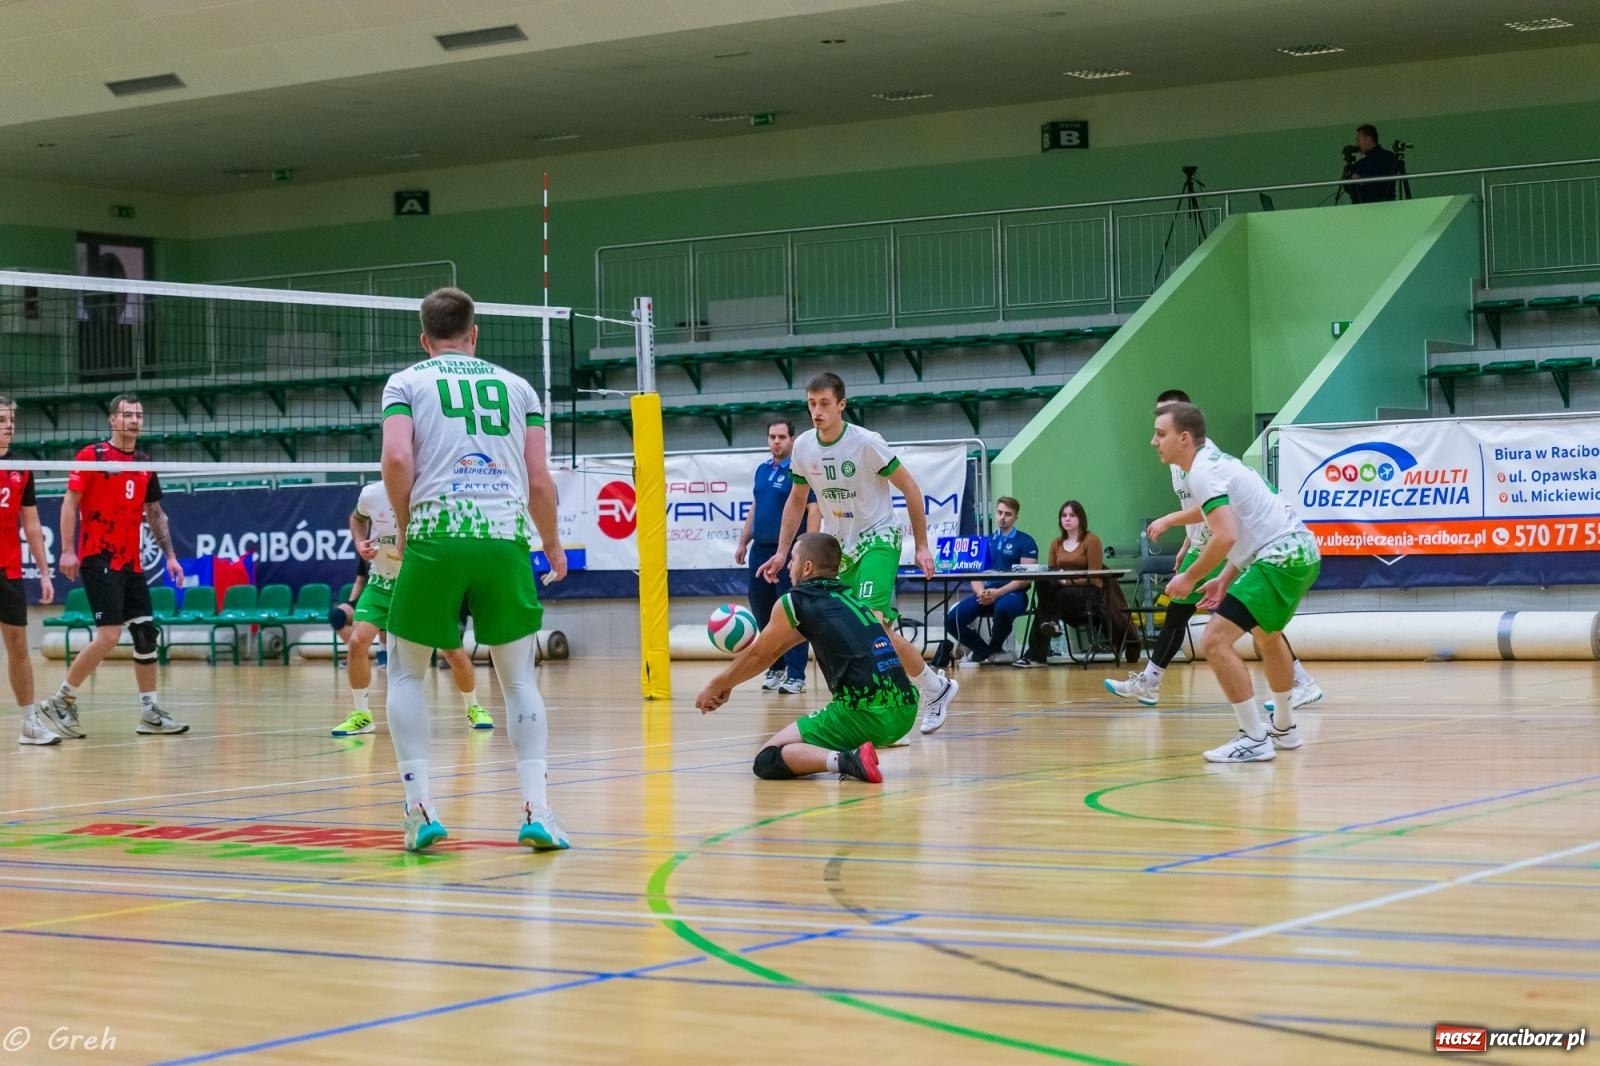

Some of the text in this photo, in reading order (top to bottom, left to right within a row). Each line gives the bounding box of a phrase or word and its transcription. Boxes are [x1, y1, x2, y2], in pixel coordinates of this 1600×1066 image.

[1060, 130, 1080, 146] B
[402, 199, 423, 213] A
[436, 379, 511, 437] 49
[1495, 447, 1532, 460] Biura
[1536, 449, 1547, 459] w
[824, 465, 836, 480] 10
[1404, 469, 1469, 486] MULTI
[1509, 468, 1597, 485] ul. Opawska
[125, 479, 135, 499] 9
[666, 481, 728, 494] ADIO
[1303, 486, 1470, 508] UBEZPIECZENIA
[1511, 490, 1527, 503] ul.
[196, 519, 356, 563] RACIBÓRZ
[1514, 522, 1600, 547] 570 77 5
[942, 541, 951, 557] 4
[970, 540, 979, 557] 5
